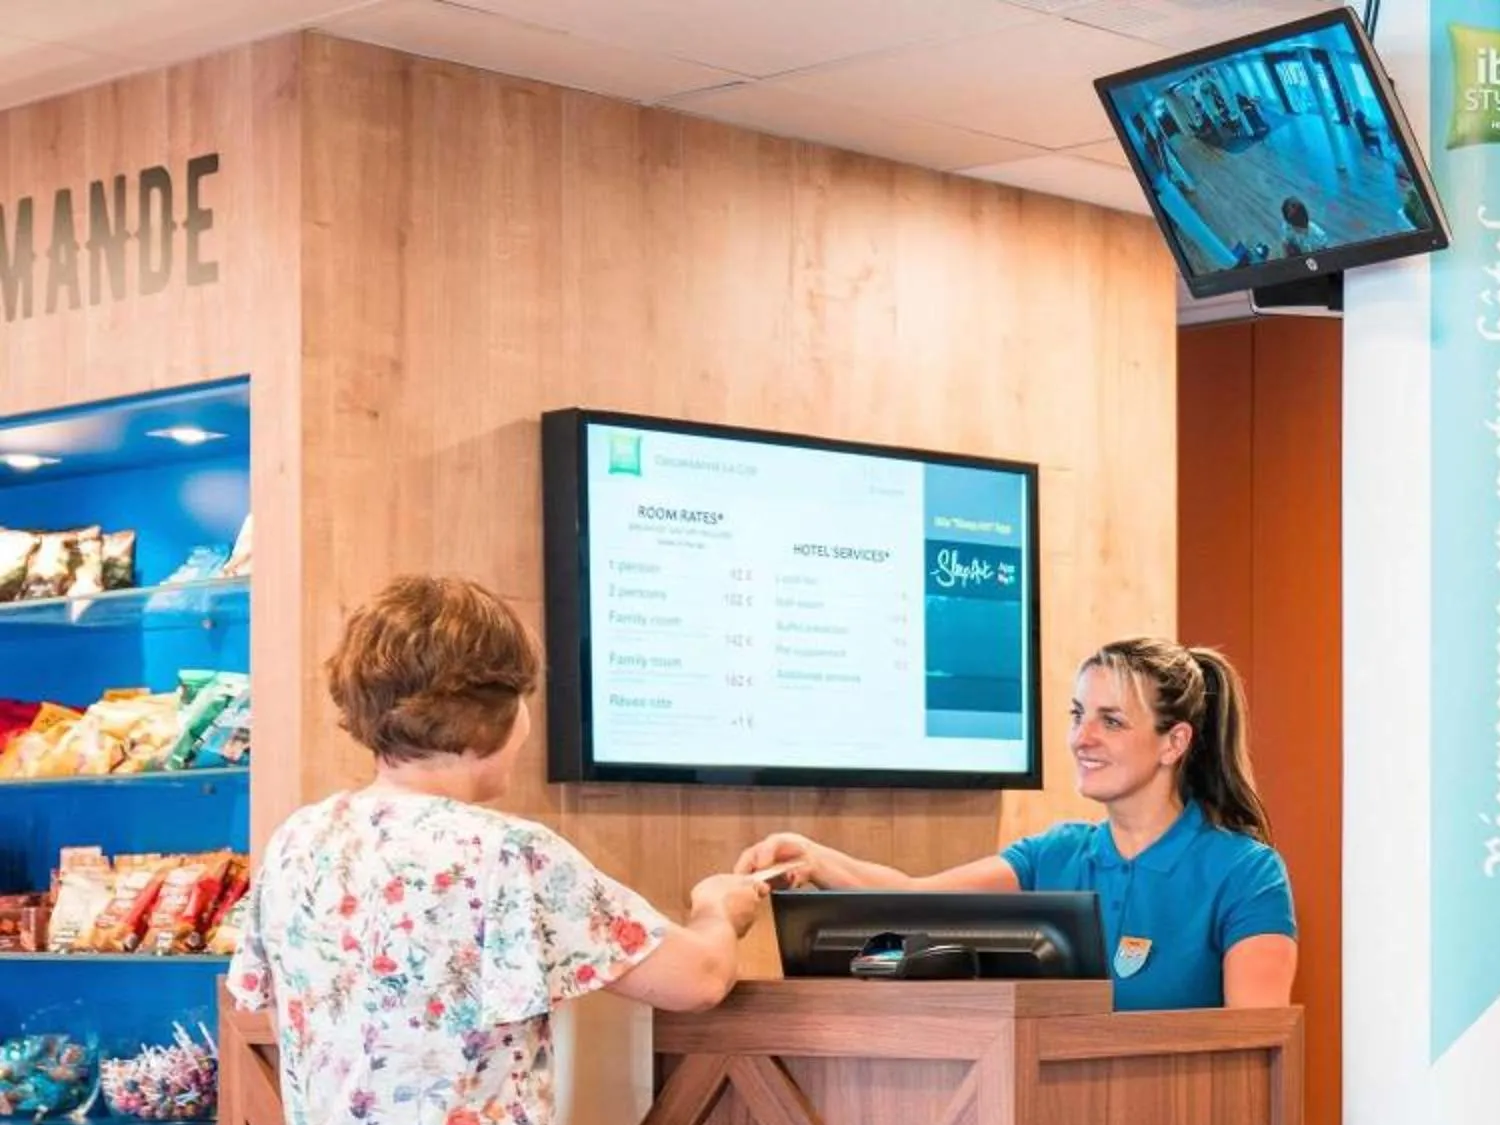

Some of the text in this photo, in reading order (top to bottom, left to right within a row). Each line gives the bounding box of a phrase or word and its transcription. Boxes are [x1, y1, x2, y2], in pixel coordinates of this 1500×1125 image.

[0, 152, 220, 324] MANDE
[637, 504, 678, 521] ROOM
[793, 543, 830, 558] HOTEL
